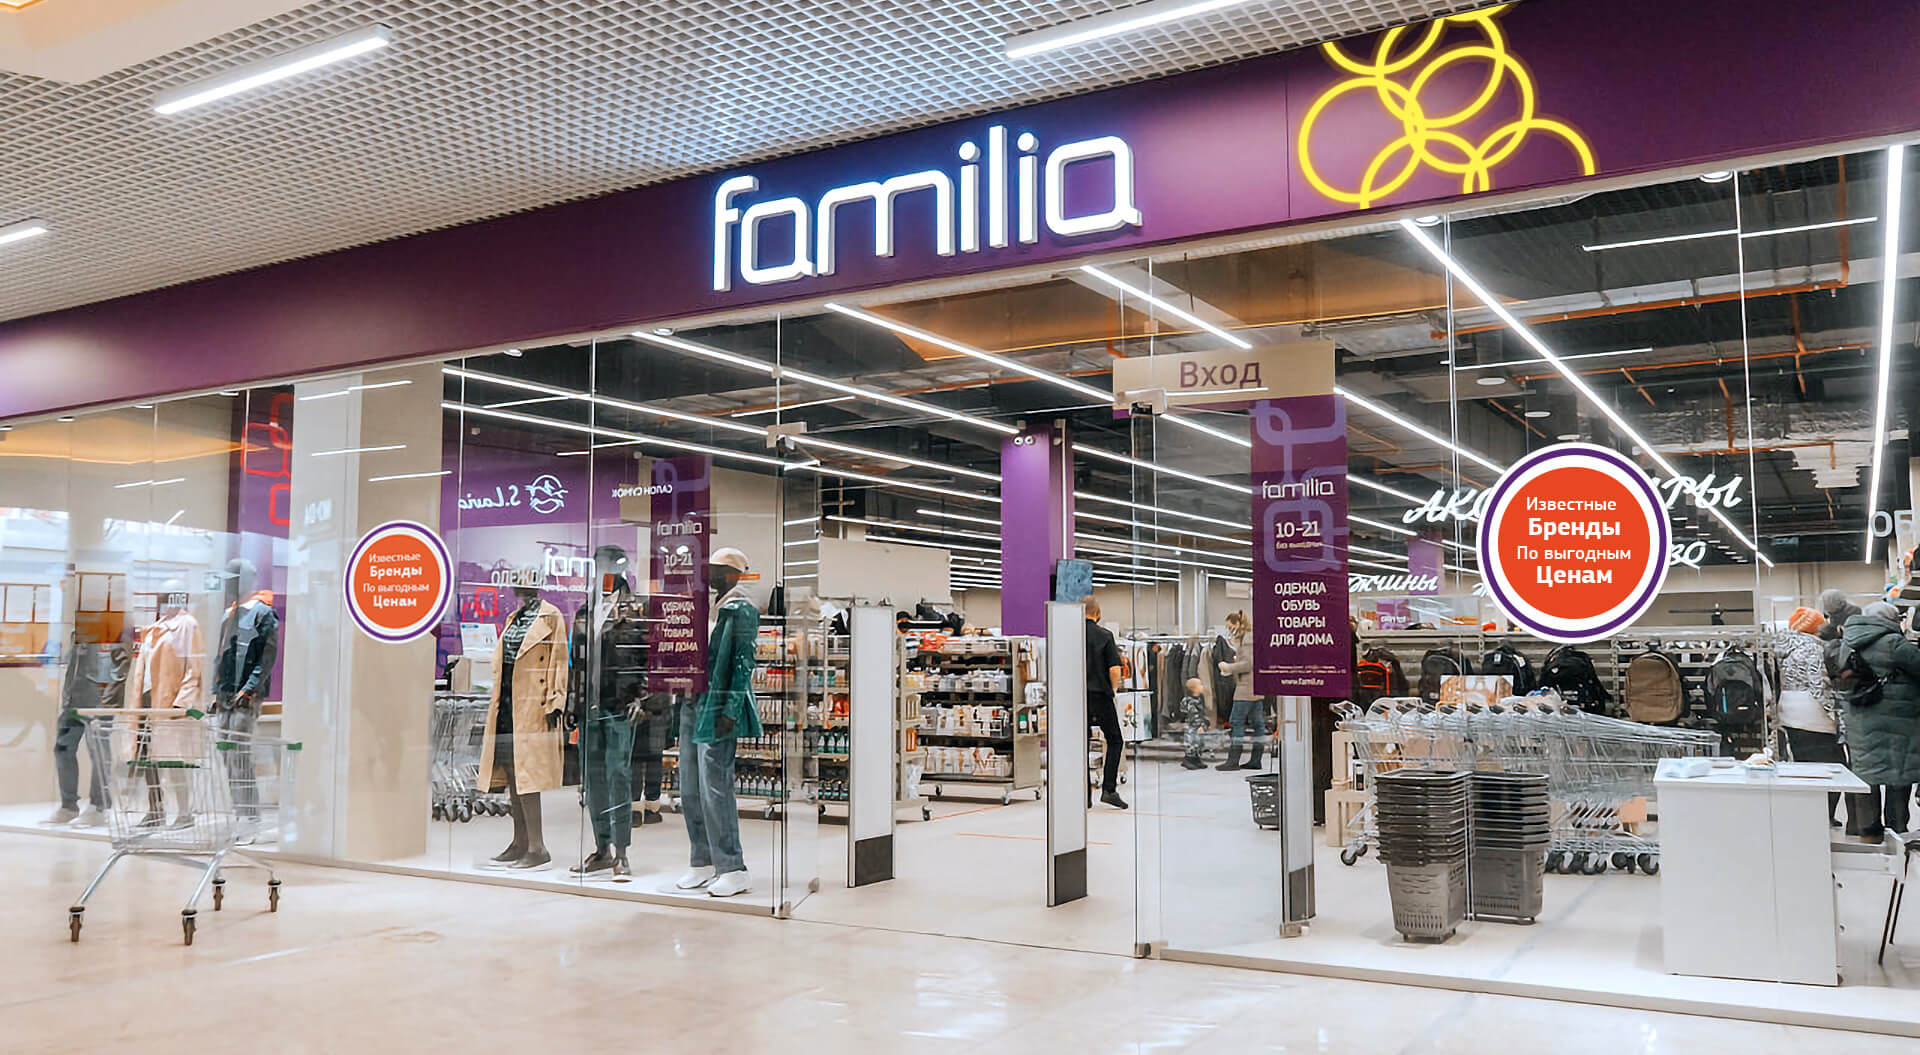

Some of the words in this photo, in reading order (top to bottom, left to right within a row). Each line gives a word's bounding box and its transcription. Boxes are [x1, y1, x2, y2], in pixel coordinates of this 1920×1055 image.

[713, 125, 1142, 292] familia
[1180, 361, 1262, 389] Вход
[1262, 477, 1336, 499] familia
[1526, 496, 1617, 511] Известные
[1275, 521, 1320, 538] 10-21
[1528, 517, 1621, 540] Бренды
[1517, 545, 1538, 560] По
[1544, 549, 1631, 563] выгодным
[369, 565, 422, 580] Бренды
[1536, 565, 1613, 588] Ценам
[363, 583, 376, 592] По
[1274, 581, 1327, 595] ОДЕЖДА
[373, 594, 417, 608] Ценам
[1281, 600, 1321, 612] ОБУВЬ
[1277, 616, 1326, 628] ТОВАРЫ
[1270, 633, 1294, 647] ДЛЯ
[1297, 632, 1334, 647] ДОМА
